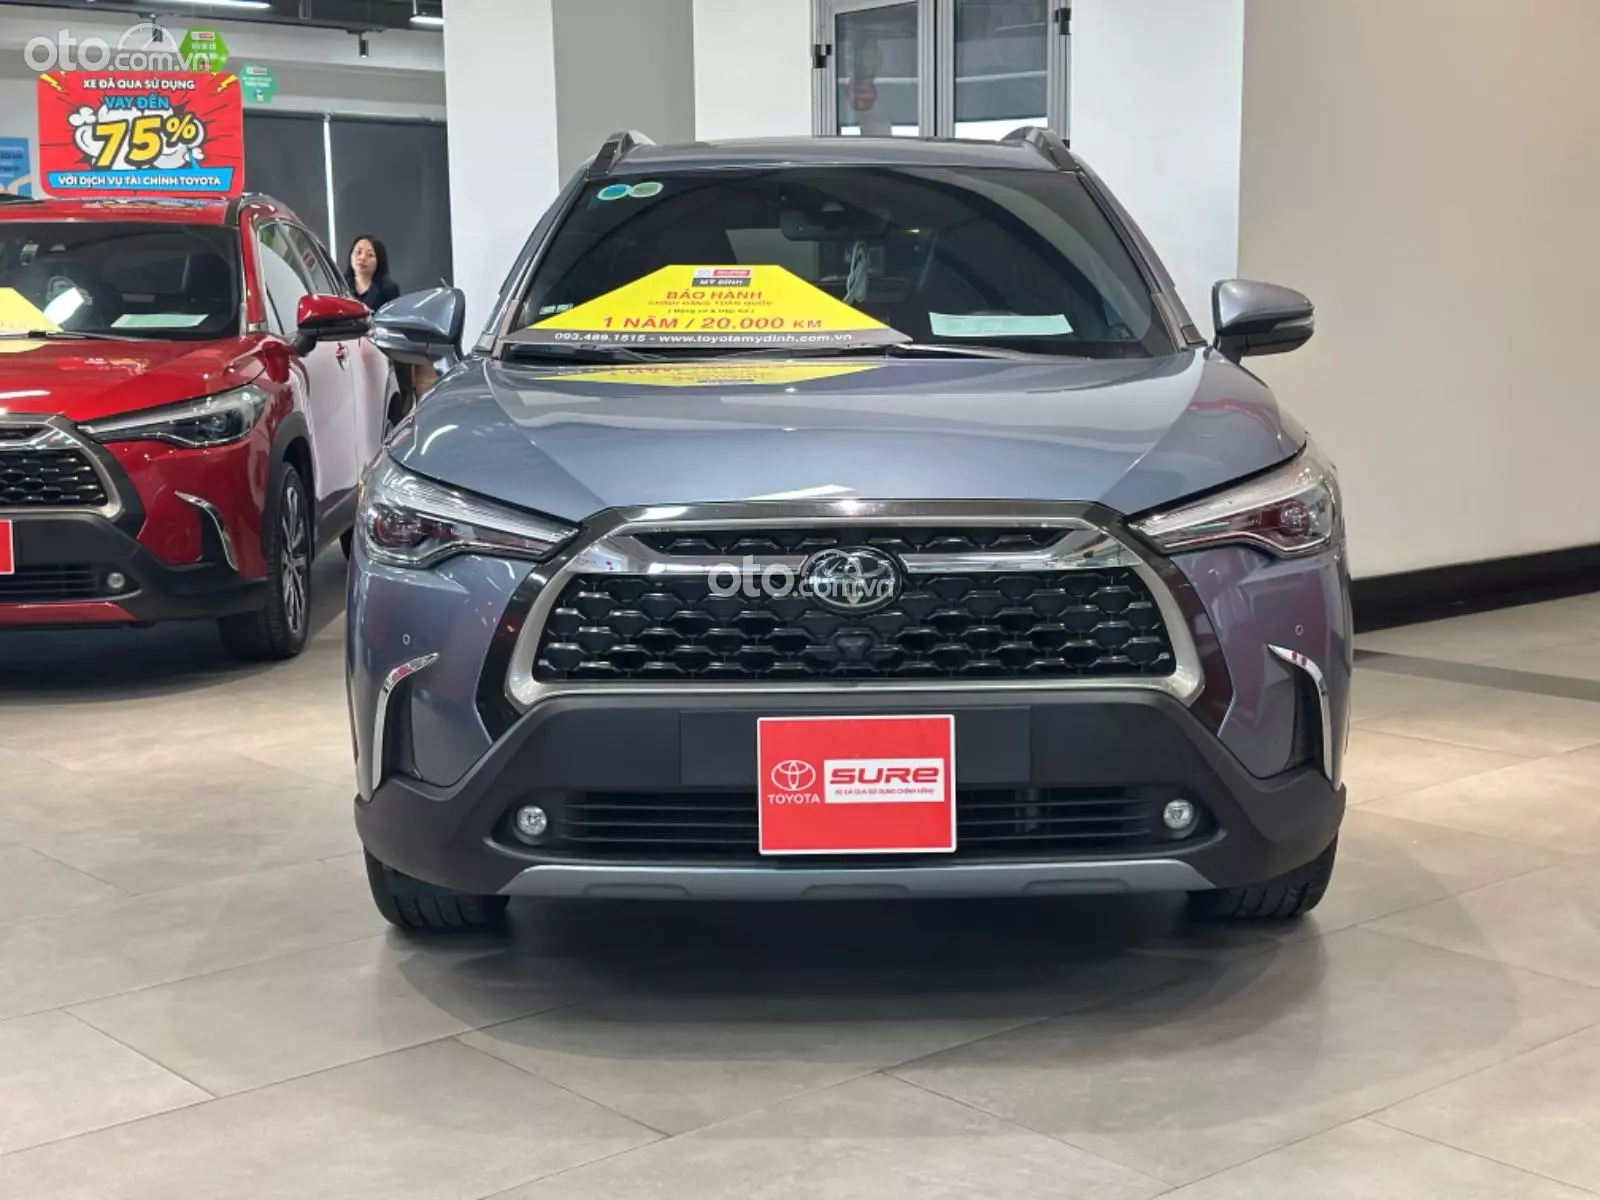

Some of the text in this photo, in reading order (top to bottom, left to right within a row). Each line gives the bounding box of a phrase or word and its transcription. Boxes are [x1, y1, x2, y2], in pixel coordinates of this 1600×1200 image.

[83, 79, 97, 89] XE
[99, 76, 116, 89] ĐÃ
[117, 79, 143, 89] QUA
[161, 79, 195, 91] DỤNG
[103, 92, 169, 109] VAY ĐẾN
[95, 113, 197, 167] 75%
[58, 173, 221, 188] VỚI DỊCH VỤ TÀI CHÍNH TOYOTA
[666, 288, 763, 299] BẢO HÀNH
[604, 317, 613, 328] 1
[685, 318, 695, 329] /
[701, 317, 785, 329] 20.000
[793, 320, 822, 328] KM
[659, 333, 853, 345] www.toyotamydinh.com.vn
[767, 793, 821, 805] TOYOTA
